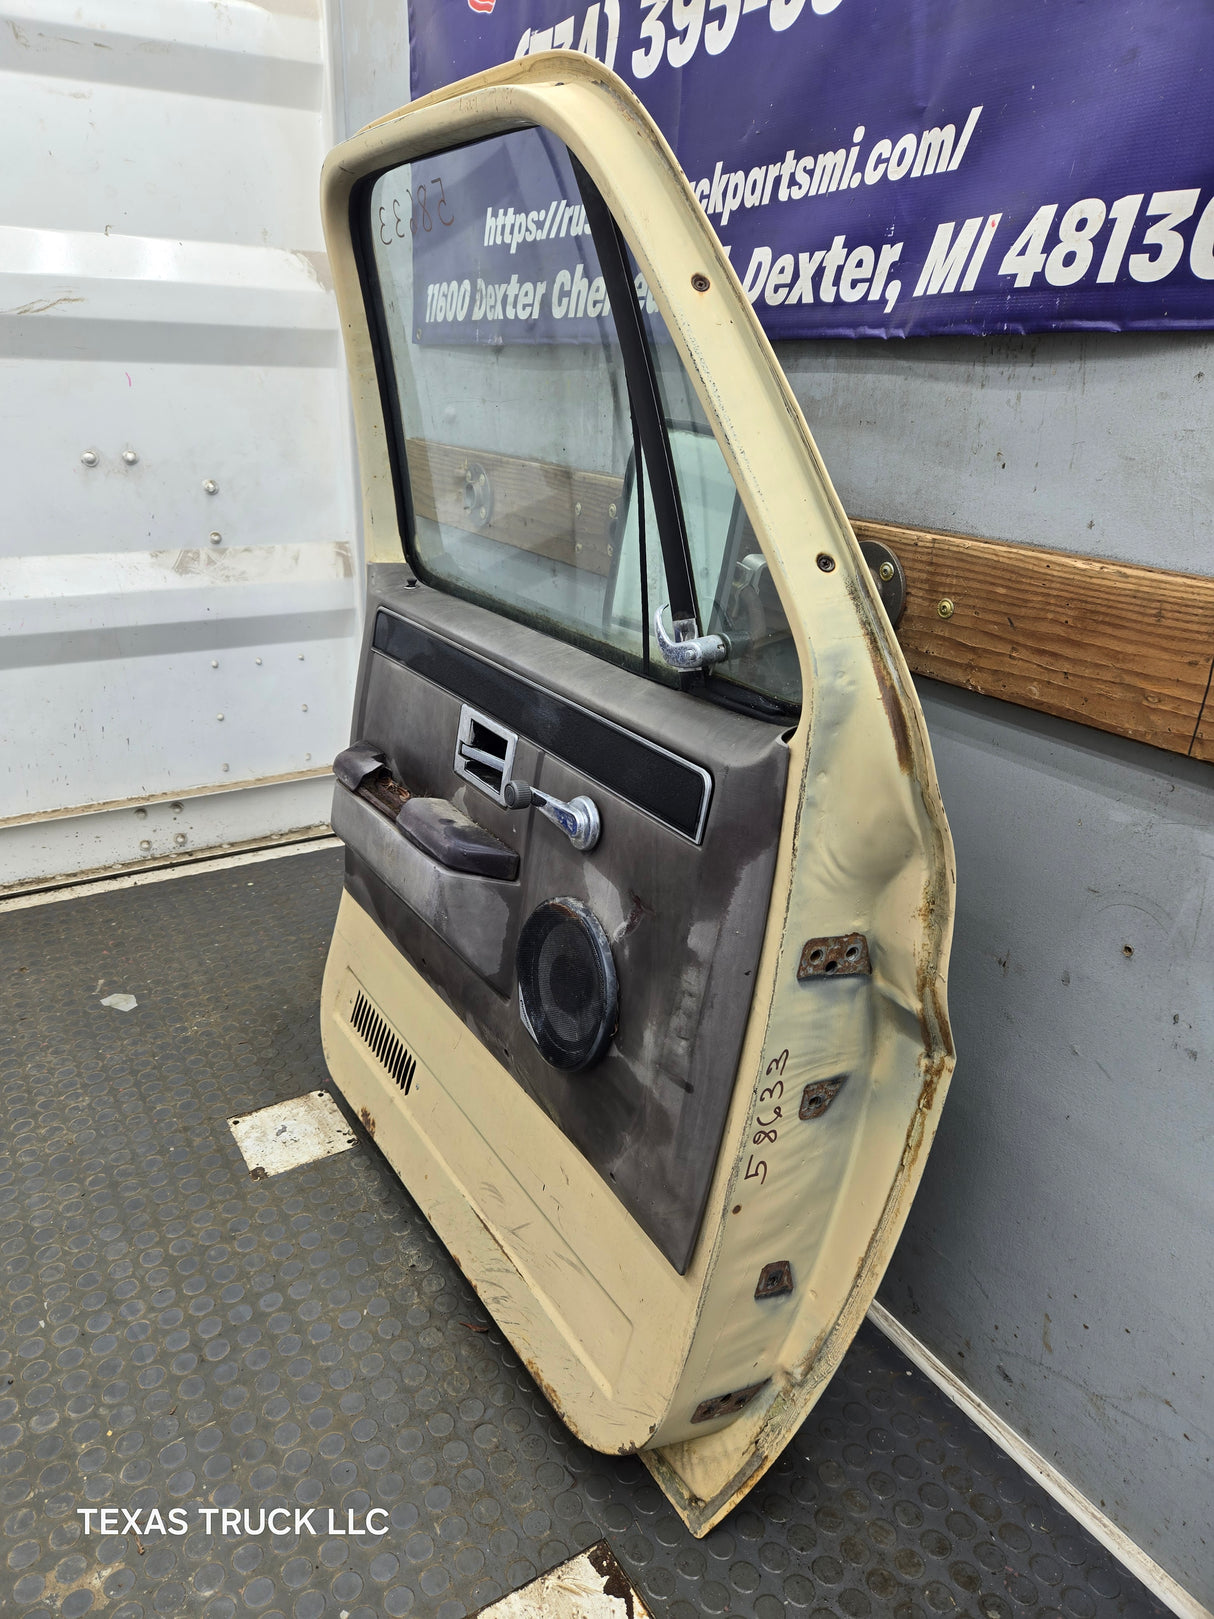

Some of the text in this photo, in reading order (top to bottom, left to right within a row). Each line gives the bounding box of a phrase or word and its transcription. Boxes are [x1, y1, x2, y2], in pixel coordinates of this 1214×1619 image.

[689, 106, 984, 226] ckpartsmi.com/
[426, 279, 471, 323] 11600
[471, 274, 547, 321] Dexter
[742, 235, 904, 314] Dexter,
[912, 213, 1003, 298] MI
[744, 1049, 789, 1185] 58633
